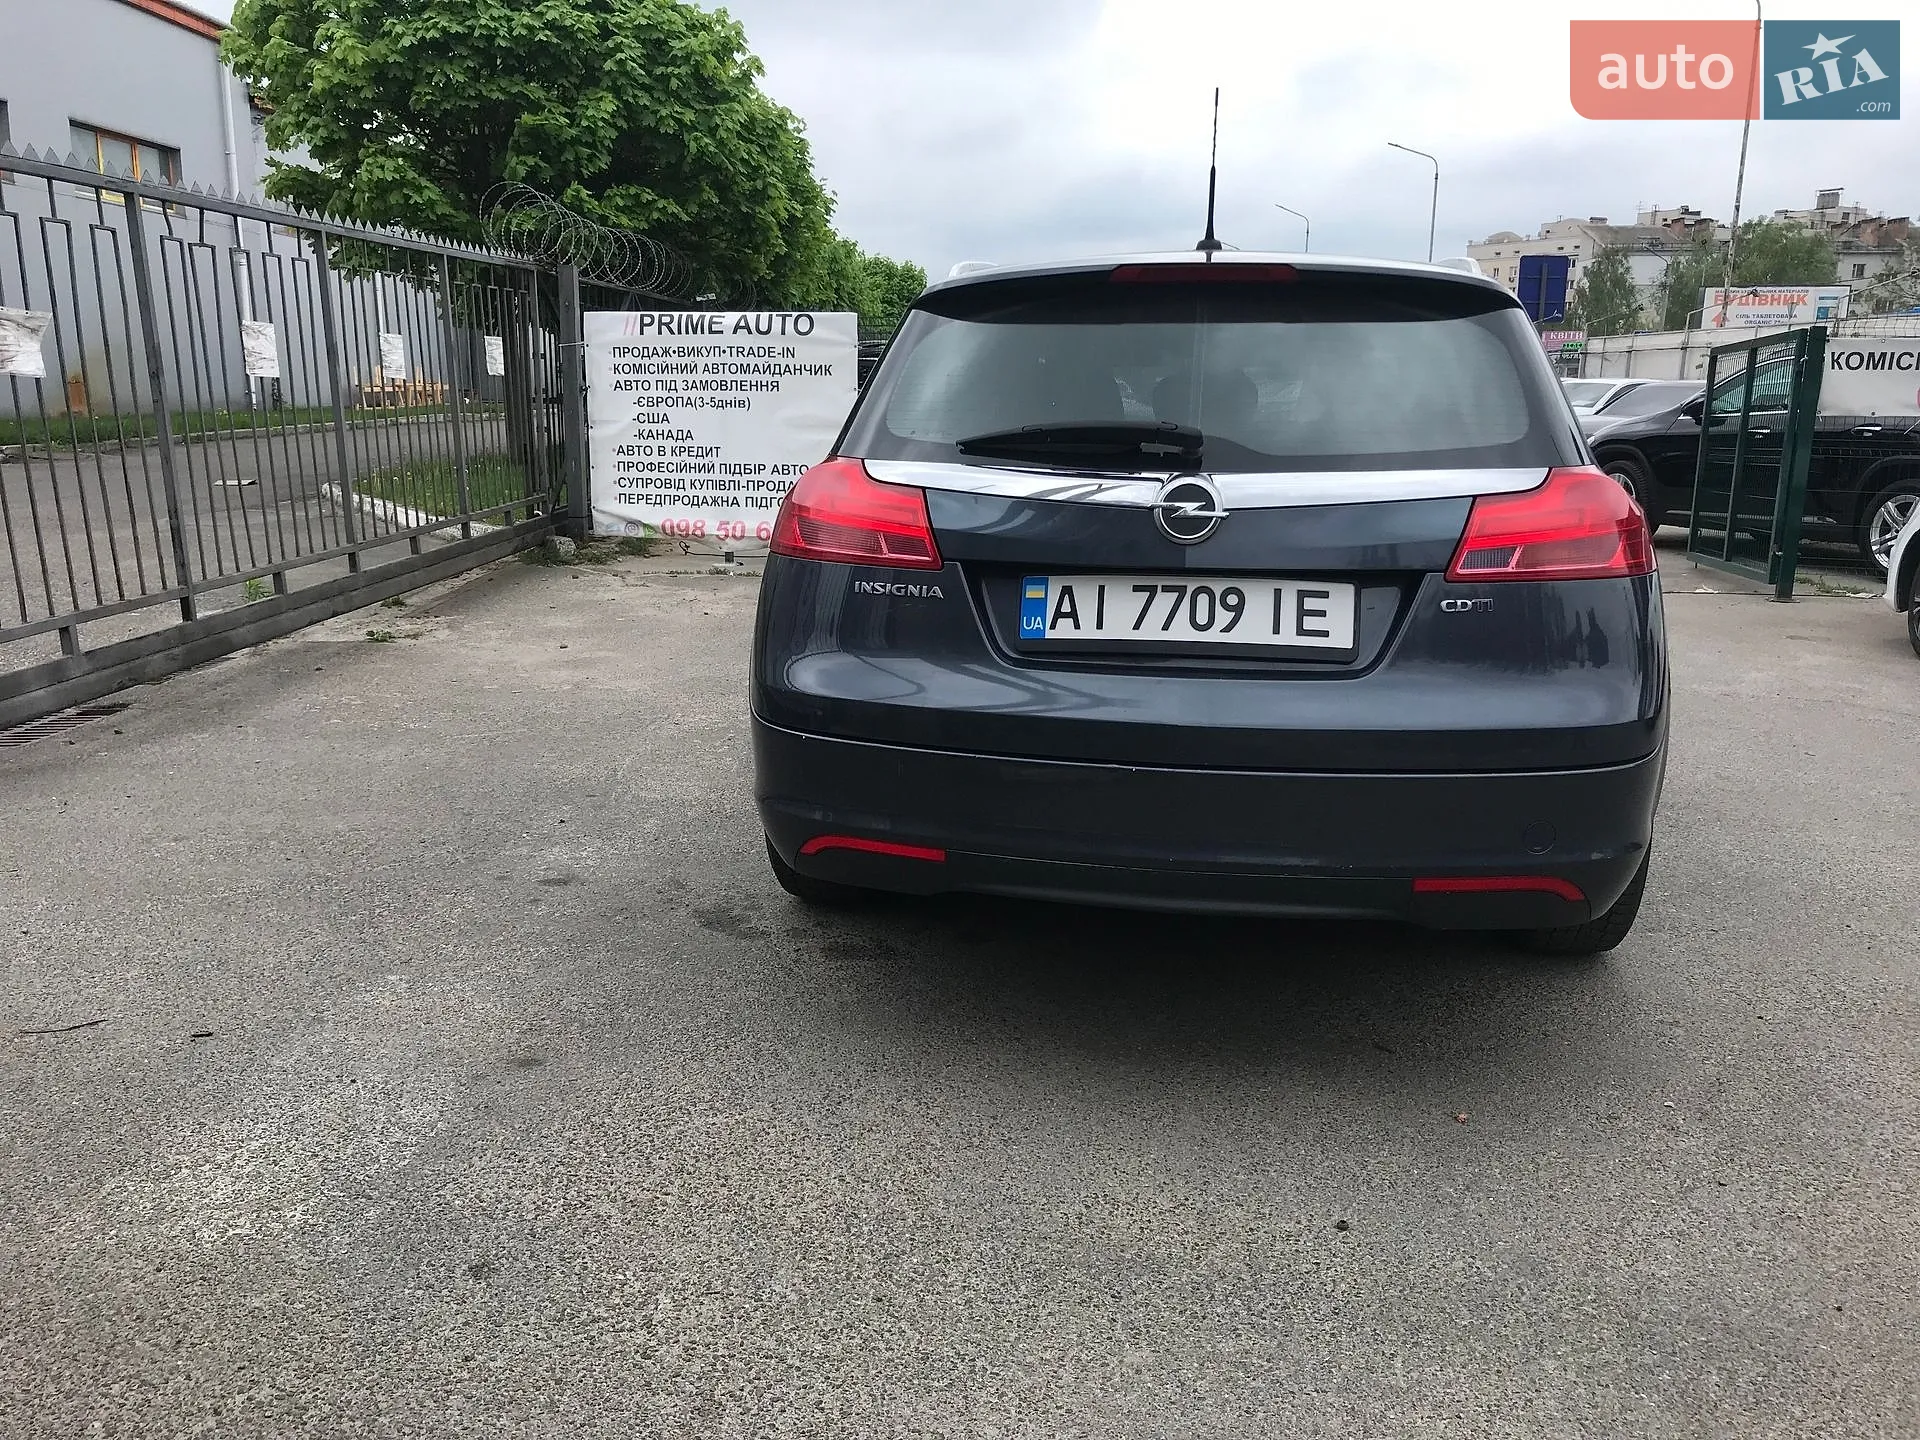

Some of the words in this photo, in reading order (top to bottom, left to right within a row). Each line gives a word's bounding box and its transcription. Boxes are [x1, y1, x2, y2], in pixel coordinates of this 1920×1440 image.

[1714, 293, 1808, 306] БУДІВНИК
[639, 313, 727, 336] PRIME
[732, 313, 815, 336] AUTO
[1550, 331, 1583, 340] КВІТИ
[613, 361, 698, 376] КОМІСІЙНИЙ
[702, 363, 833, 378] АВТОМАЙДАНЧИК
[613, 379, 651, 392] АВТО
[655, 379, 678, 394] ПІД
[682, 379, 780, 393] ЗАМОВЛЕННЯ
[632, 412, 670, 424] -США
[633, 429, 694, 442] -КАНАДА
[616, 445, 653, 457] АВТО
[657, 446, 667, 458] В
[670, 446, 721, 459] КРЕДИТ
[617, 460, 716, 475] ПРОФЕСІЙНИЙ
[719, 463, 767, 477] ПІДБІР
[770, 464, 809, 476] АВТО
[617, 477, 687, 492] СУПРОВІД
[618, 493, 740, 509] ПЕРЕДПРОДАЖНА
[660, 518, 707, 539] 098
[715, 519, 746, 541] 50
[854, 581, 944, 599] INSIGNIA
[1049, 585, 1104, 630] AI
[1132, 585, 1246, 633] 7709
[1272, 588, 1330, 637] IE
[1440, 598, 1494, 612] CDTI
[1023, 616, 1044, 630] UA
